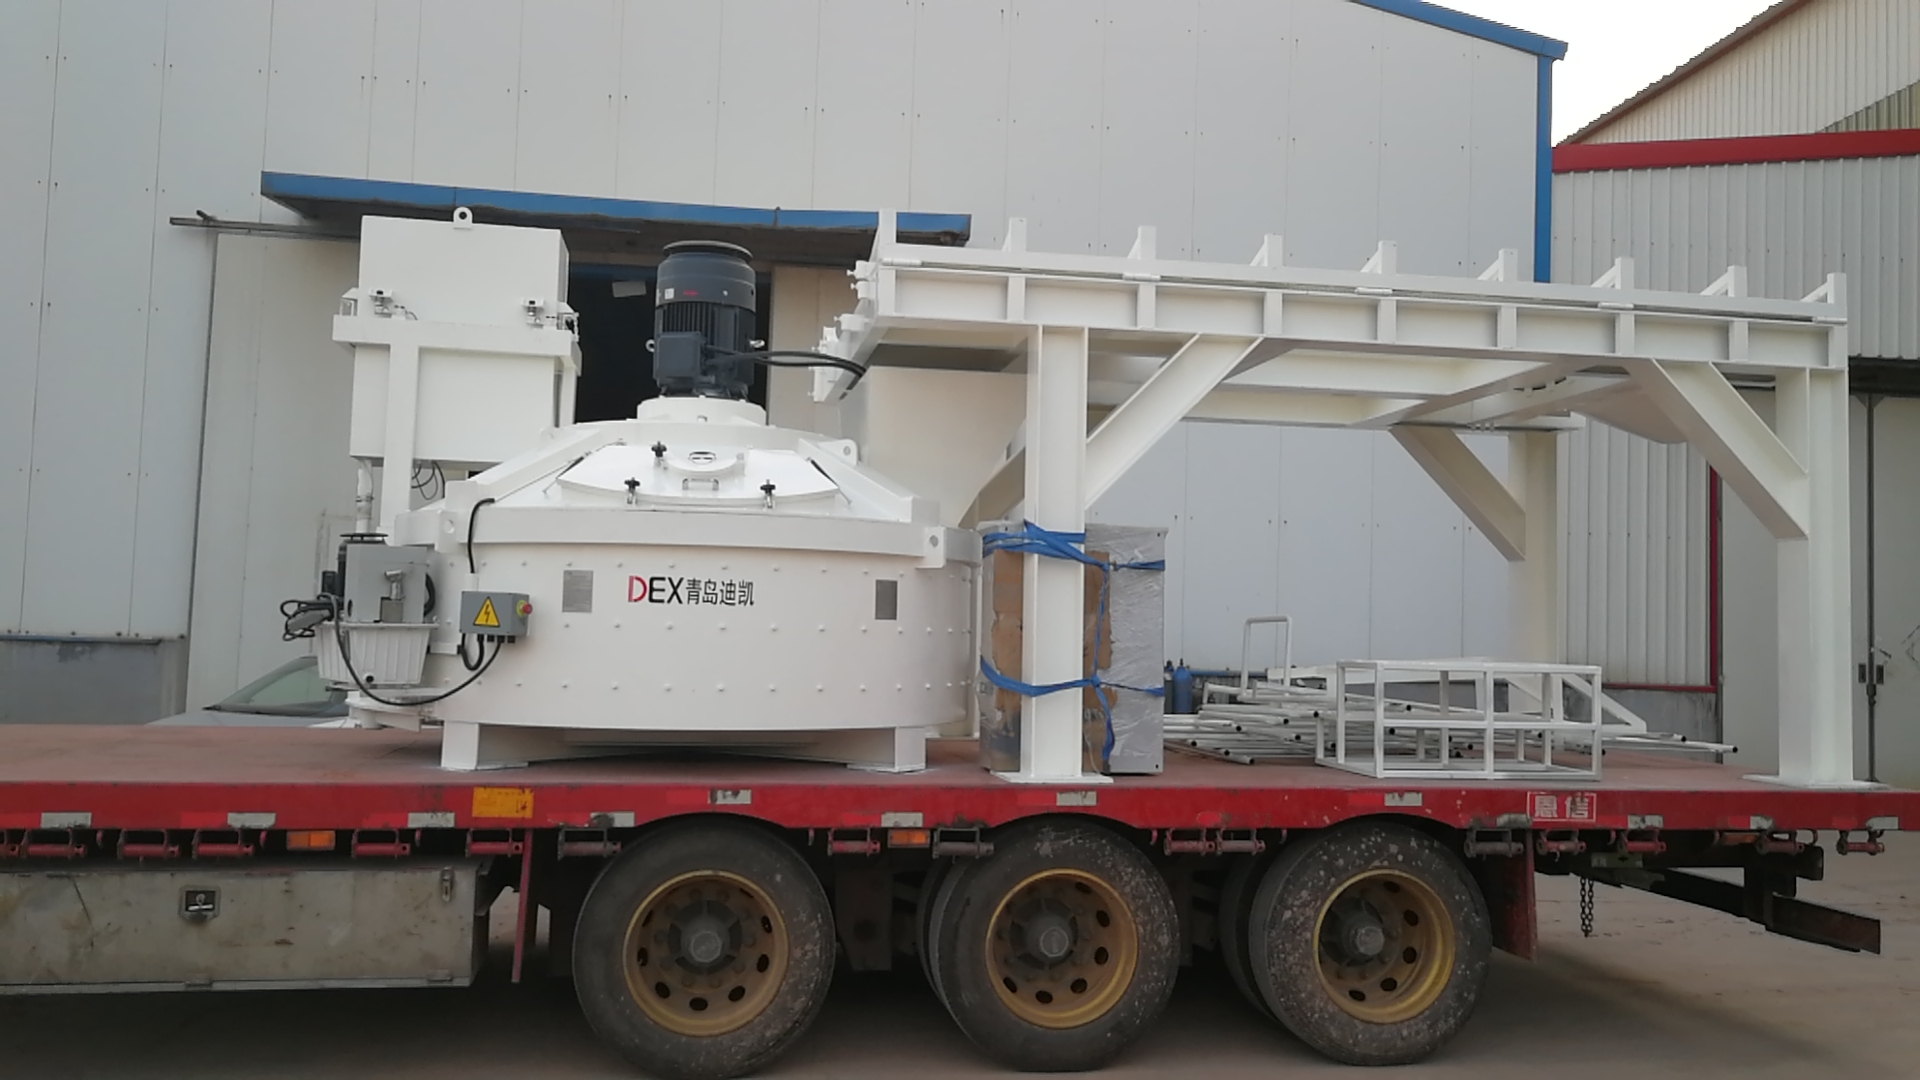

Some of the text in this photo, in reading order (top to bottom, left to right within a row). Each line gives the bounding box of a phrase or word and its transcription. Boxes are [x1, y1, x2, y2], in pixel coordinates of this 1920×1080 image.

[628, 575, 754, 606] DEX 青岛迪凯
